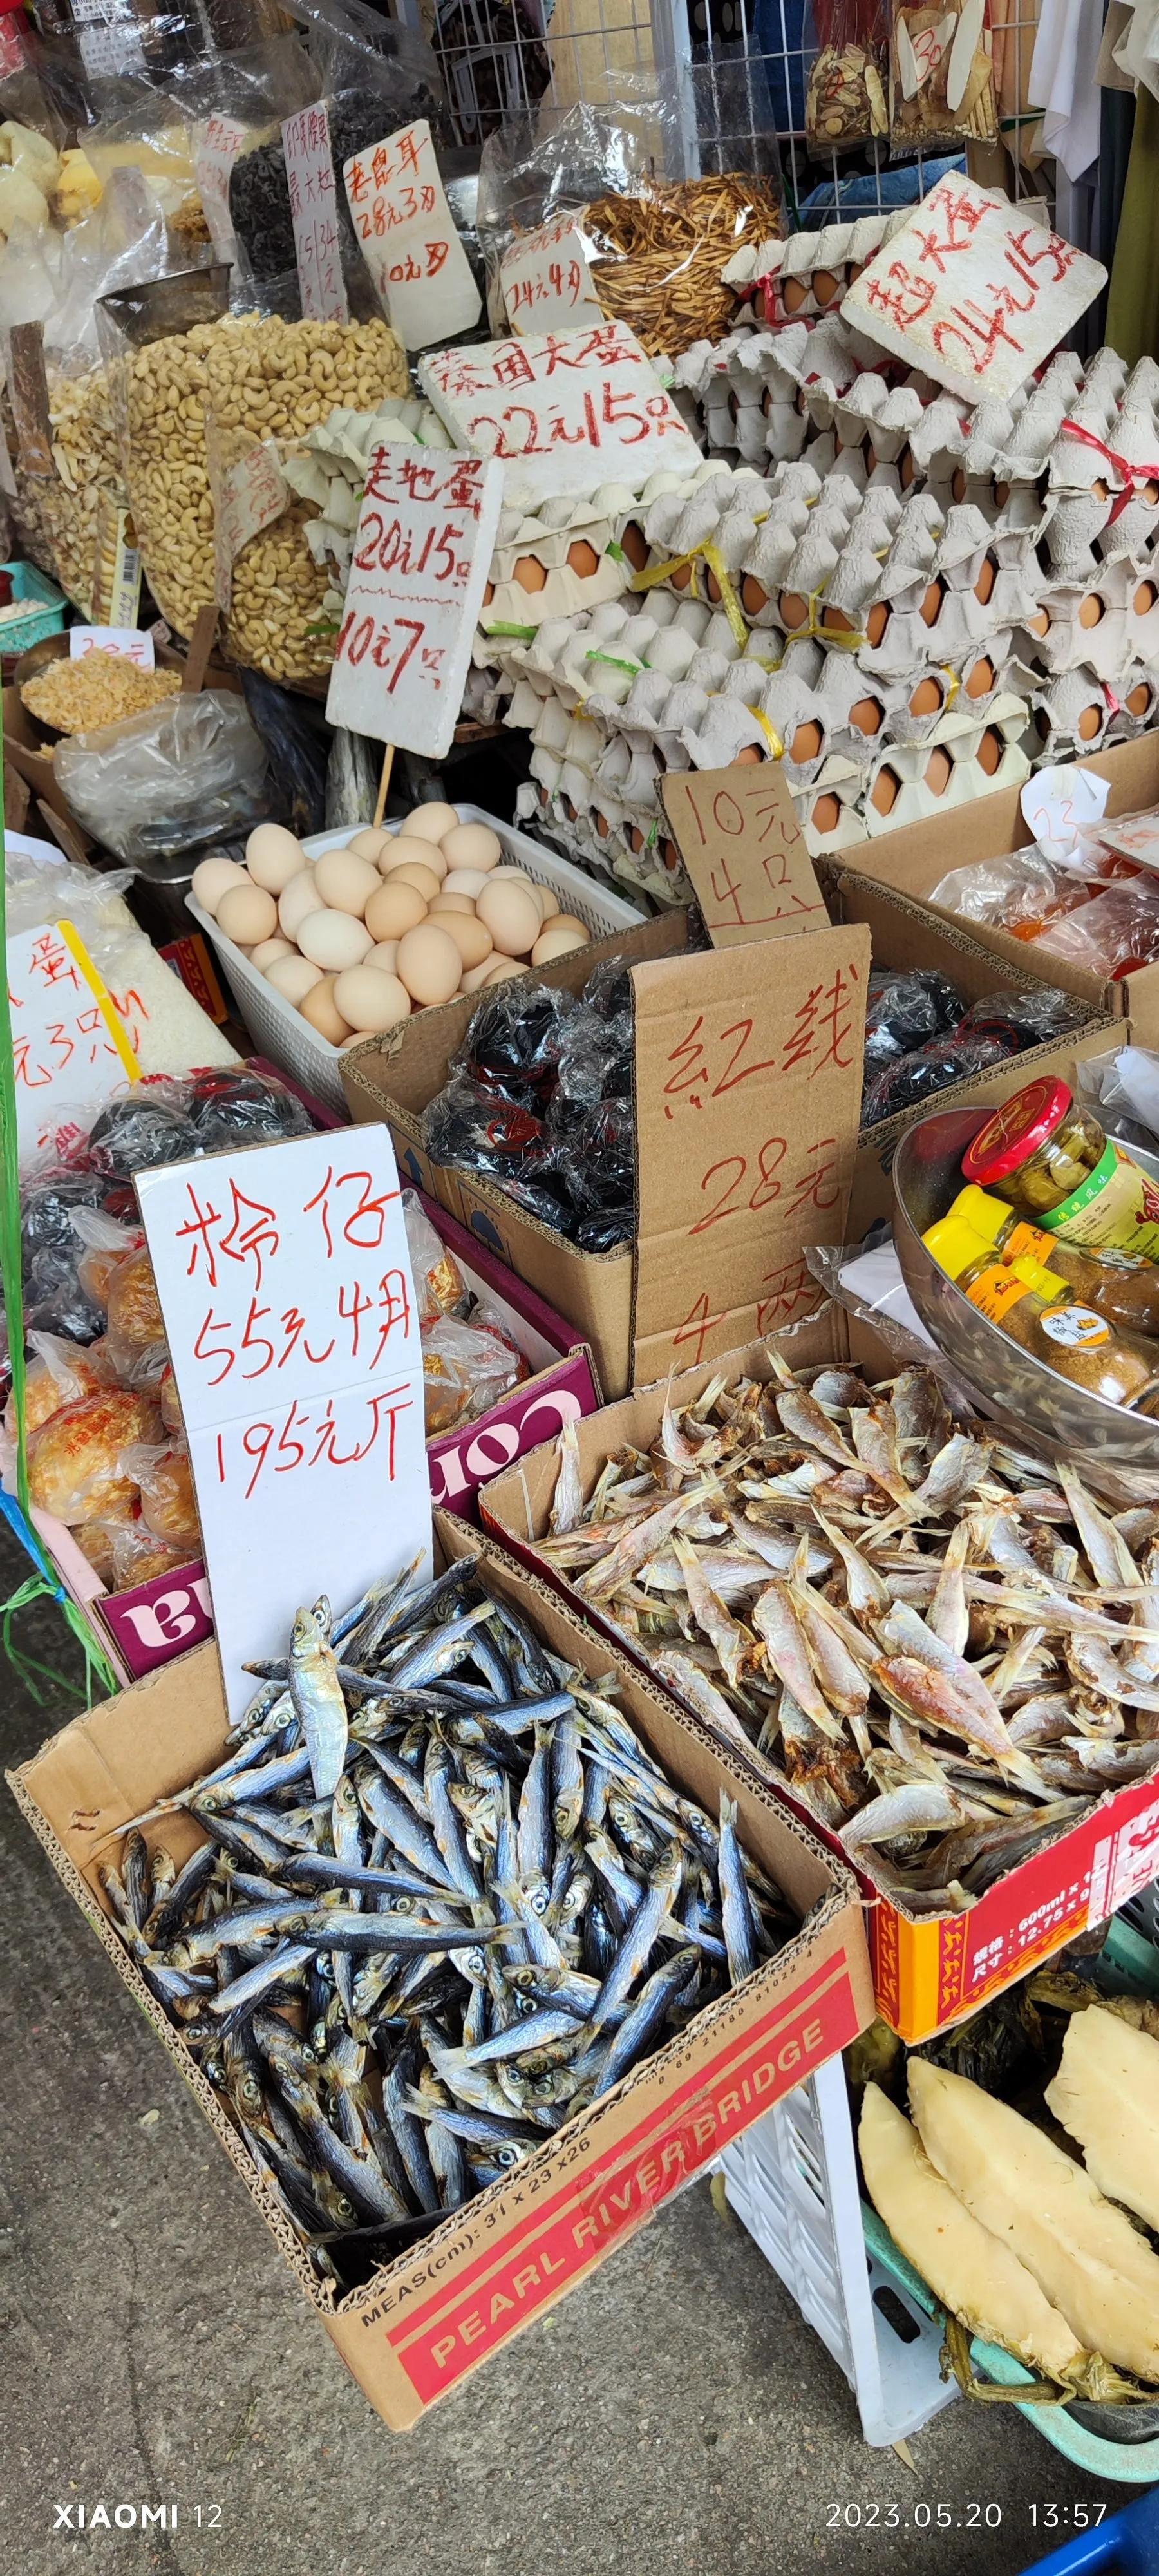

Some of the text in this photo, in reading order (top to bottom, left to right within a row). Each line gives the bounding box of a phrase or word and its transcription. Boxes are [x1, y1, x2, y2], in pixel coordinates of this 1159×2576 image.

[344, 129, 428, 202] 老鼠耳
[467, 381, 688, 459] 22元15只
[364, 446, 484, 521] 走地蛋
[685, 785, 802, 845] 10元
[710, 853, 813, 925] 4只
[688, 1137, 840, 1235] 28元
[1018, 1890, 1066, 1933] 600ml
[432, 2018, 825, 2369] PEARL RIVER BRIDGE
[361, 2228, 481, 2327] MEAS(cm):
[528, 2168, 552, 2194] 23
